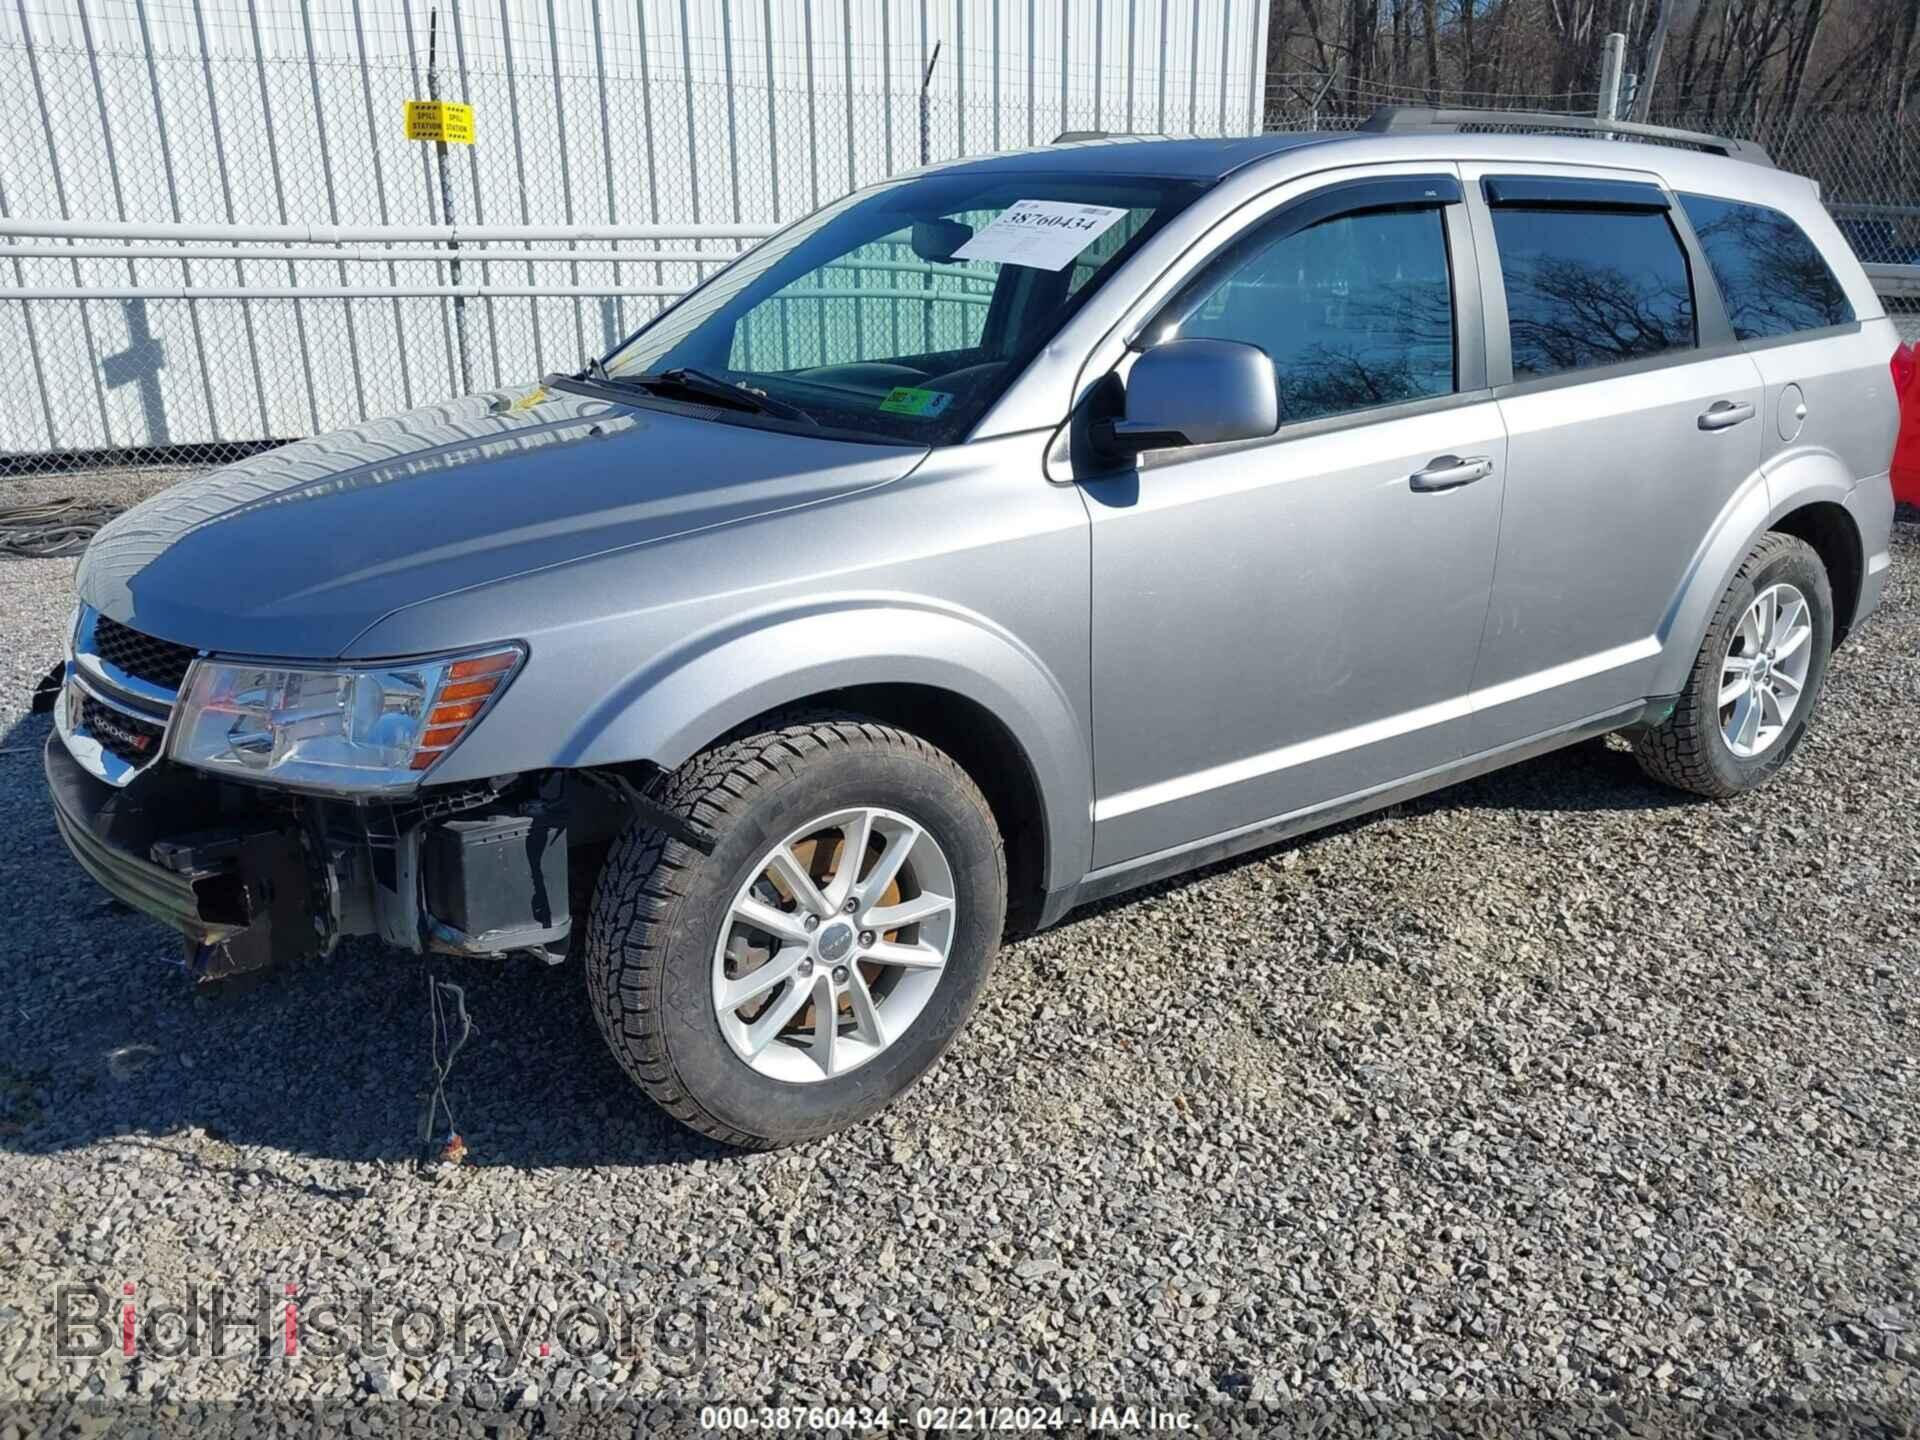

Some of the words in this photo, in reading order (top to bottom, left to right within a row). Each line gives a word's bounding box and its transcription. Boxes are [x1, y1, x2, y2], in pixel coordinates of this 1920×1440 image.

[417, 112, 436, 120] SPILL
[413, 122, 441, 130] STATION
[1004, 212, 1097, 231] 38760434
[95, 716, 139, 746] DODGE
